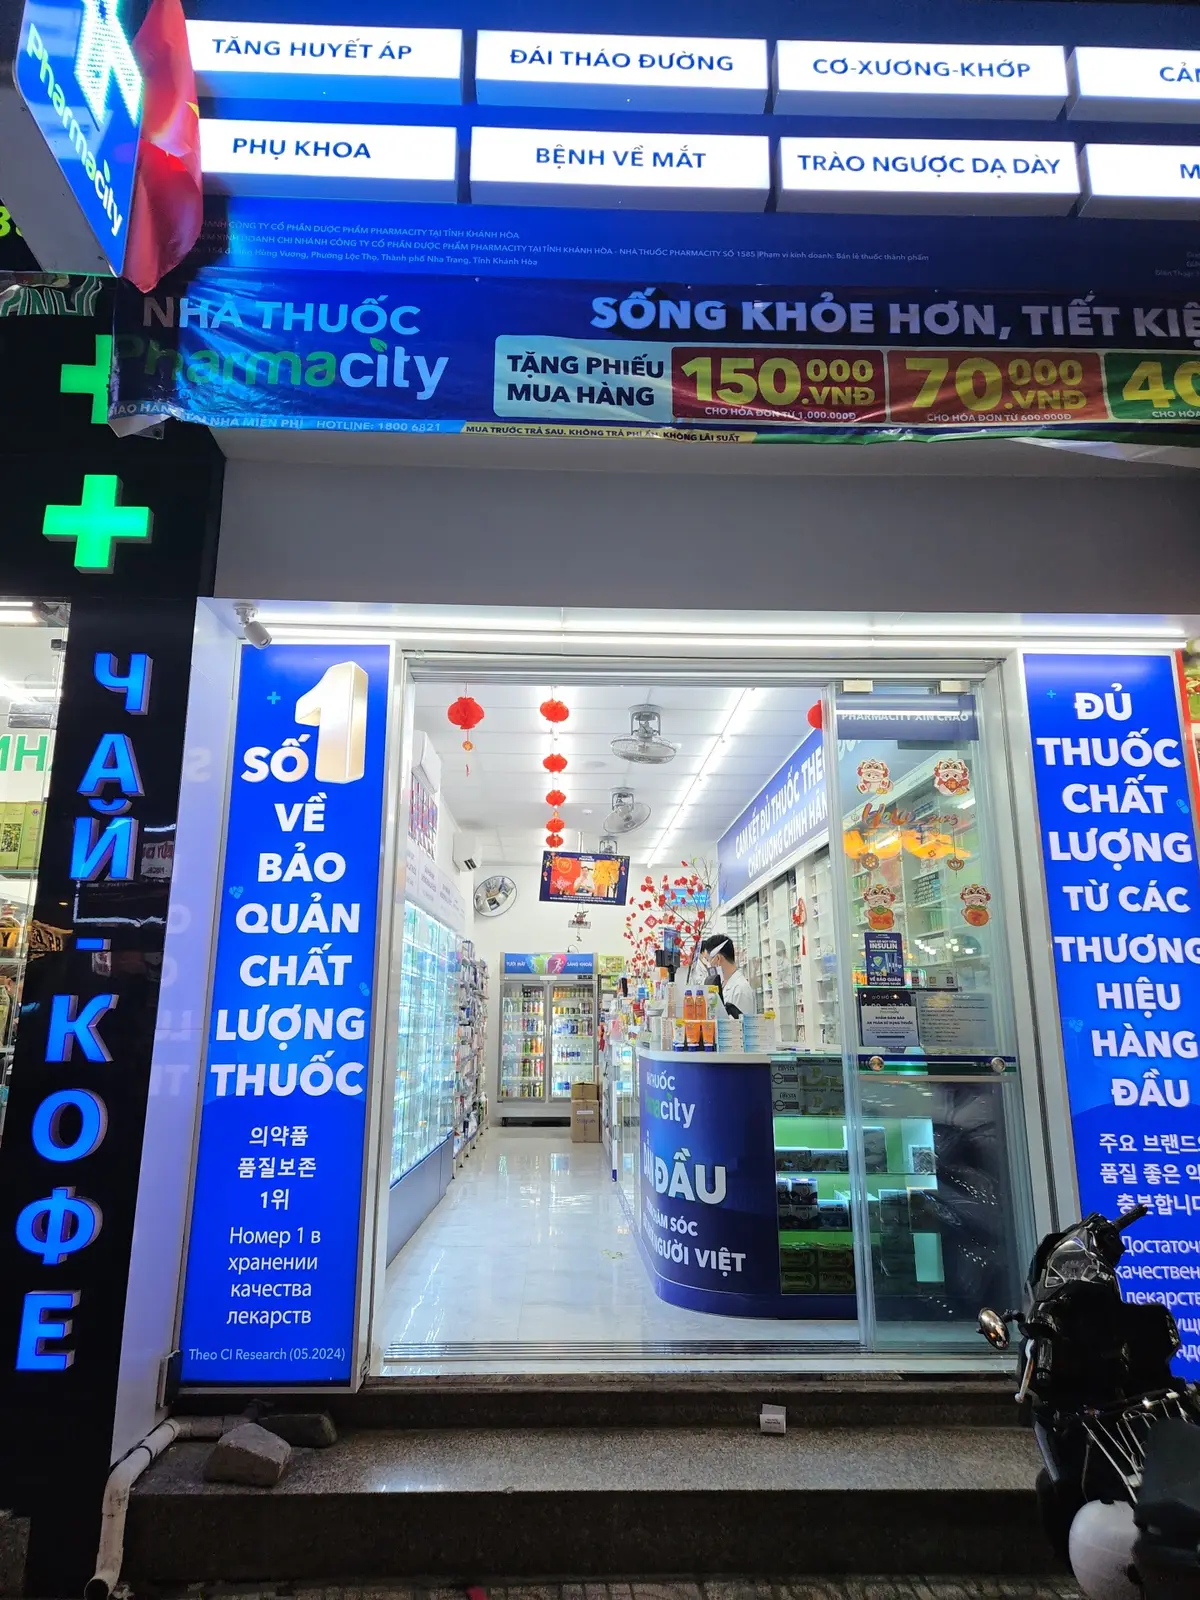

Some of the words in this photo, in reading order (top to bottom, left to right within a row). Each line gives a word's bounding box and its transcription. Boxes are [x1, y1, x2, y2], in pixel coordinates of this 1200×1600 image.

[211, 35, 281, 56] TĂNG
[289, 38, 373, 59] HUYẾT
[378, 40, 412, 60] ÁP
[510, 45, 552, 65] ĐÁI
[559, 48, 631, 68] THÁO
[637, 50, 734, 71] ĐƯỜNG
[812, 57, 1031, 78] CƠ-XƯƠNG-KHỚP
[232, 137, 286, 161] PHỤ
[294, 140, 372, 159] KHOA
[535, 143, 605, 170] BỆNH
[612, 144, 644, 167] VỀ
[652, 144, 707, 168] MẮT
[797, 151, 865, 172] TRÀO
[872, 155, 966, 179] NGƯỢC
[971, 157, 1007, 179] DẠ
[1012, 154, 1061, 175] DÀY
[258, 222, 269, 231] TY
[370, 227, 428, 237] PHARMACITY
[277, 236, 293, 245] CHI
[358, 239, 370, 248] TY
[470, 243, 528, 253] PHARMACITY
[669, 249, 721, 258] PHARMACITY
[252, 294, 421, 335] THUỐC
[590, 287, 727, 330] SỐNG
[741, 291, 875, 334] KHỎE
[889, 300, 1011, 340] HƠN,
[1021, 291, 1120, 336] TIẾT
[113, 333, 449, 400] Pharmacity
[507, 352, 579, 378] TẶNG
[586, 353, 664, 378] PHIẾU
[507, 384, 570, 402] MUA
[577, 382, 655, 406] HÀNG
[705, 407, 728, 415] CHO
[927, 413, 950, 422] CHO
[952, 413, 976, 422] HÓA
[978, 413, 1002, 422] ĐƠN
[1003, 412, 1019, 422] TỪ
[1151, 410, 1176, 418] CHO
[316, 420, 374, 431] HOTLINE:
[379, 422, 408, 432] 1800
[411, 423, 441, 433] 6821
[490, 426, 524, 434] TRƯỚC
[663, 432, 697, 441] KHÔNG
[716, 433, 740, 442] SUẤT
[1074, 683, 1133, 721] ĐỦ
[240, 733, 311, 784] SỐ
[293, 660, 369, 785] 1
[1036, 728, 1181, 768] THUỐC
[770, 765, 800, 825] THUỐC
[1062, 774, 1168, 814] CHẤT
[273, 791, 327, 833] VỀ
[783, 811, 808, 849] CHÍNH
[257, 842, 346, 883] BẢO
[1048, 828, 1193, 871] LƯỢNG
[1062, 881, 1110, 913] TỪ
[1118, 880, 1191, 913] CÁC
[235, 892, 360, 934] QUẢN
[869, 942, 898, 950] INSULIN
[1054, 933, 1200, 963] THƯƠNG
[239, 942, 353, 987] CHẤT
[1096, 976, 1182, 1018] HIỆU
[215, 1003, 365, 1050] LƯỢNG
[1091, 1022, 1199, 1059] HÀNG
[210, 1049, 365, 1097] THUỐC
[1110, 1068, 1191, 1108] ĐẦU
[249, 1125, 309, 1147] 의약품
[1099, 1133, 1138, 1154] 주요
[237, 1157, 317, 1178] 품질보존
[654, 1148, 727, 1205] ĐẦU
[1100, 1163, 1138, 1184] 품질
[1143, 1163, 1181, 1185] 좋은
[259, 1188, 290, 1210] 1위
[229, 1227, 291, 1248] Номер
[297, 1226, 304, 1244] 1
[310, 1230, 321, 1244] в
[670, 1215, 698, 1237] SÓC
[228, 1256, 318, 1275] хранении
[694, 1246, 747, 1277] VIỆT
[230, 1282, 312, 1297] качества
[226, 1309, 312, 1329] лекарств
[189, 1348, 218, 1361] Theo
[235, 1348, 287, 1361] Research
[289, 1347, 346, 1362] (05.2024)
